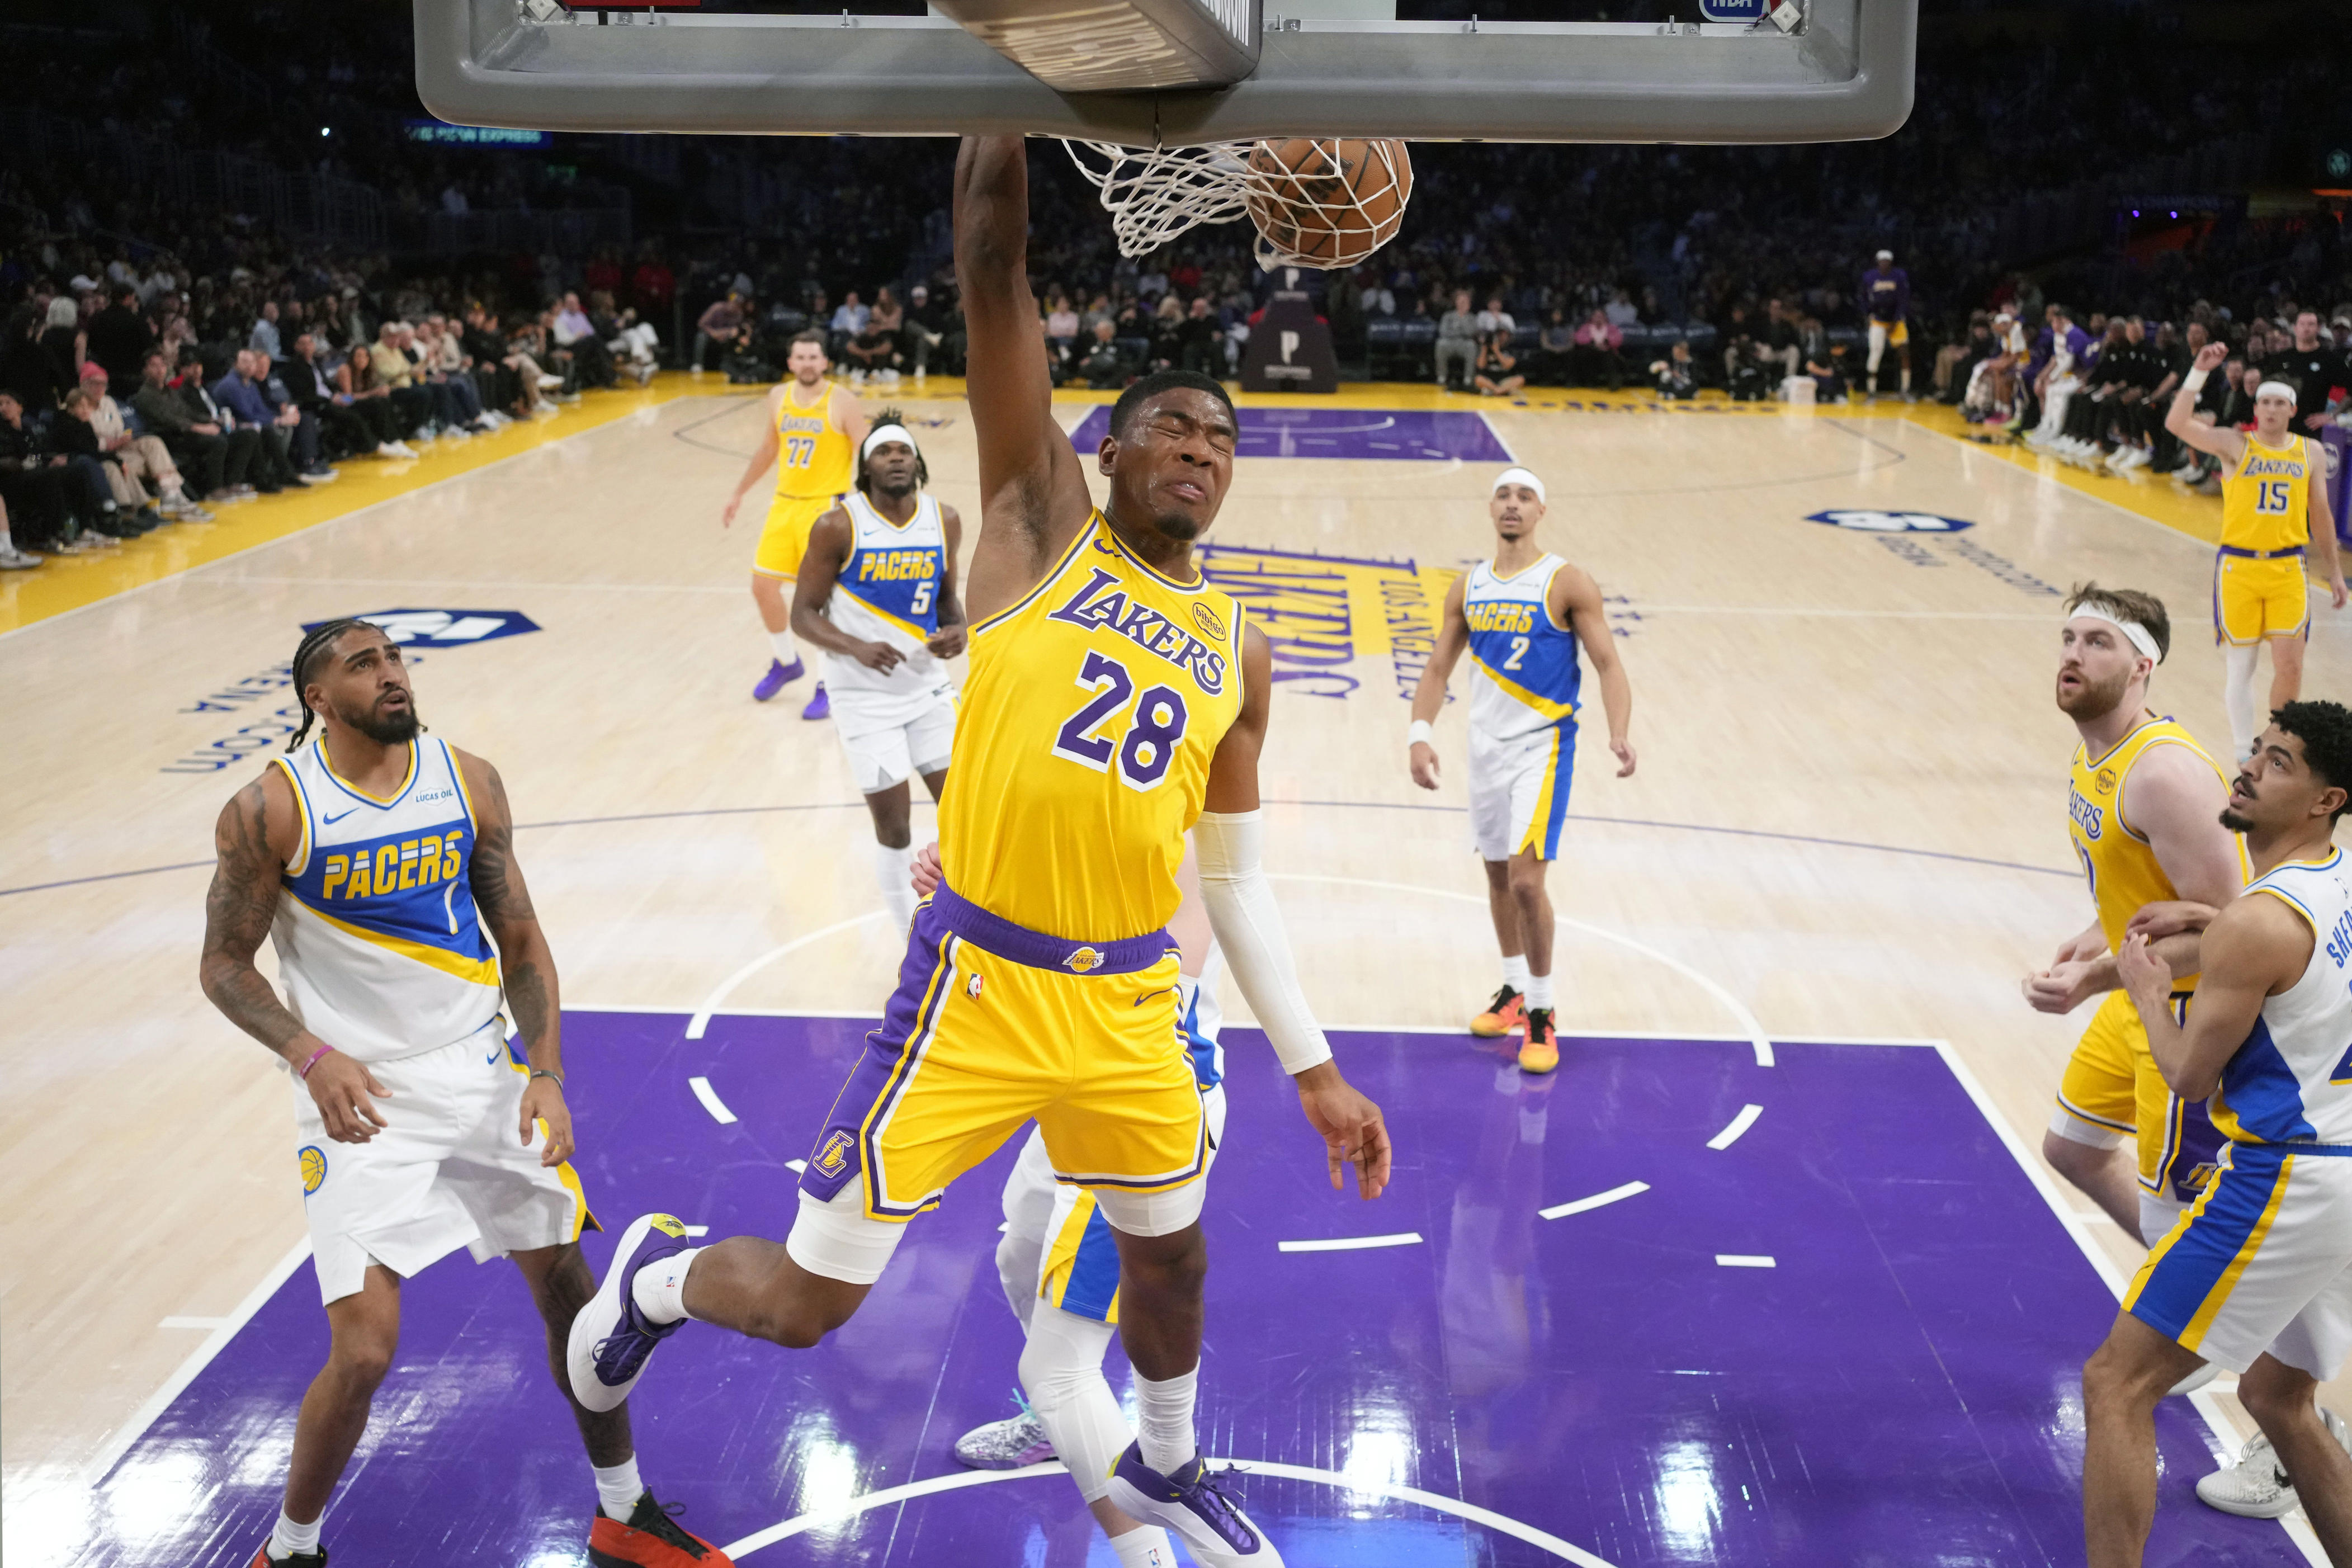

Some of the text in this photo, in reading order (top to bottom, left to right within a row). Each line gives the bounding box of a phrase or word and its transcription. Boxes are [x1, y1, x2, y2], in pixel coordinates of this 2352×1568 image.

[787, 437, 816, 467] 77
[2242, 456, 2304, 479] LAKERS
[2256, 481, 2290, 515] 15
[858, 550, 938, 582] PACERS
[910, 582, 934, 615] 5
[1046, 565, 1227, 698] LAKERS
[1196, 606, 1224, 635] bibigo
[1466, 602, 1538, 634] PACERS
[1503, 636, 1531, 671] 2
[1051, 648, 1189, 793] 28
[415, 788, 454, 803] LUCAS OIL
[323, 830, 464, 900] PACERS
[443, 880, 459, 936] 1
